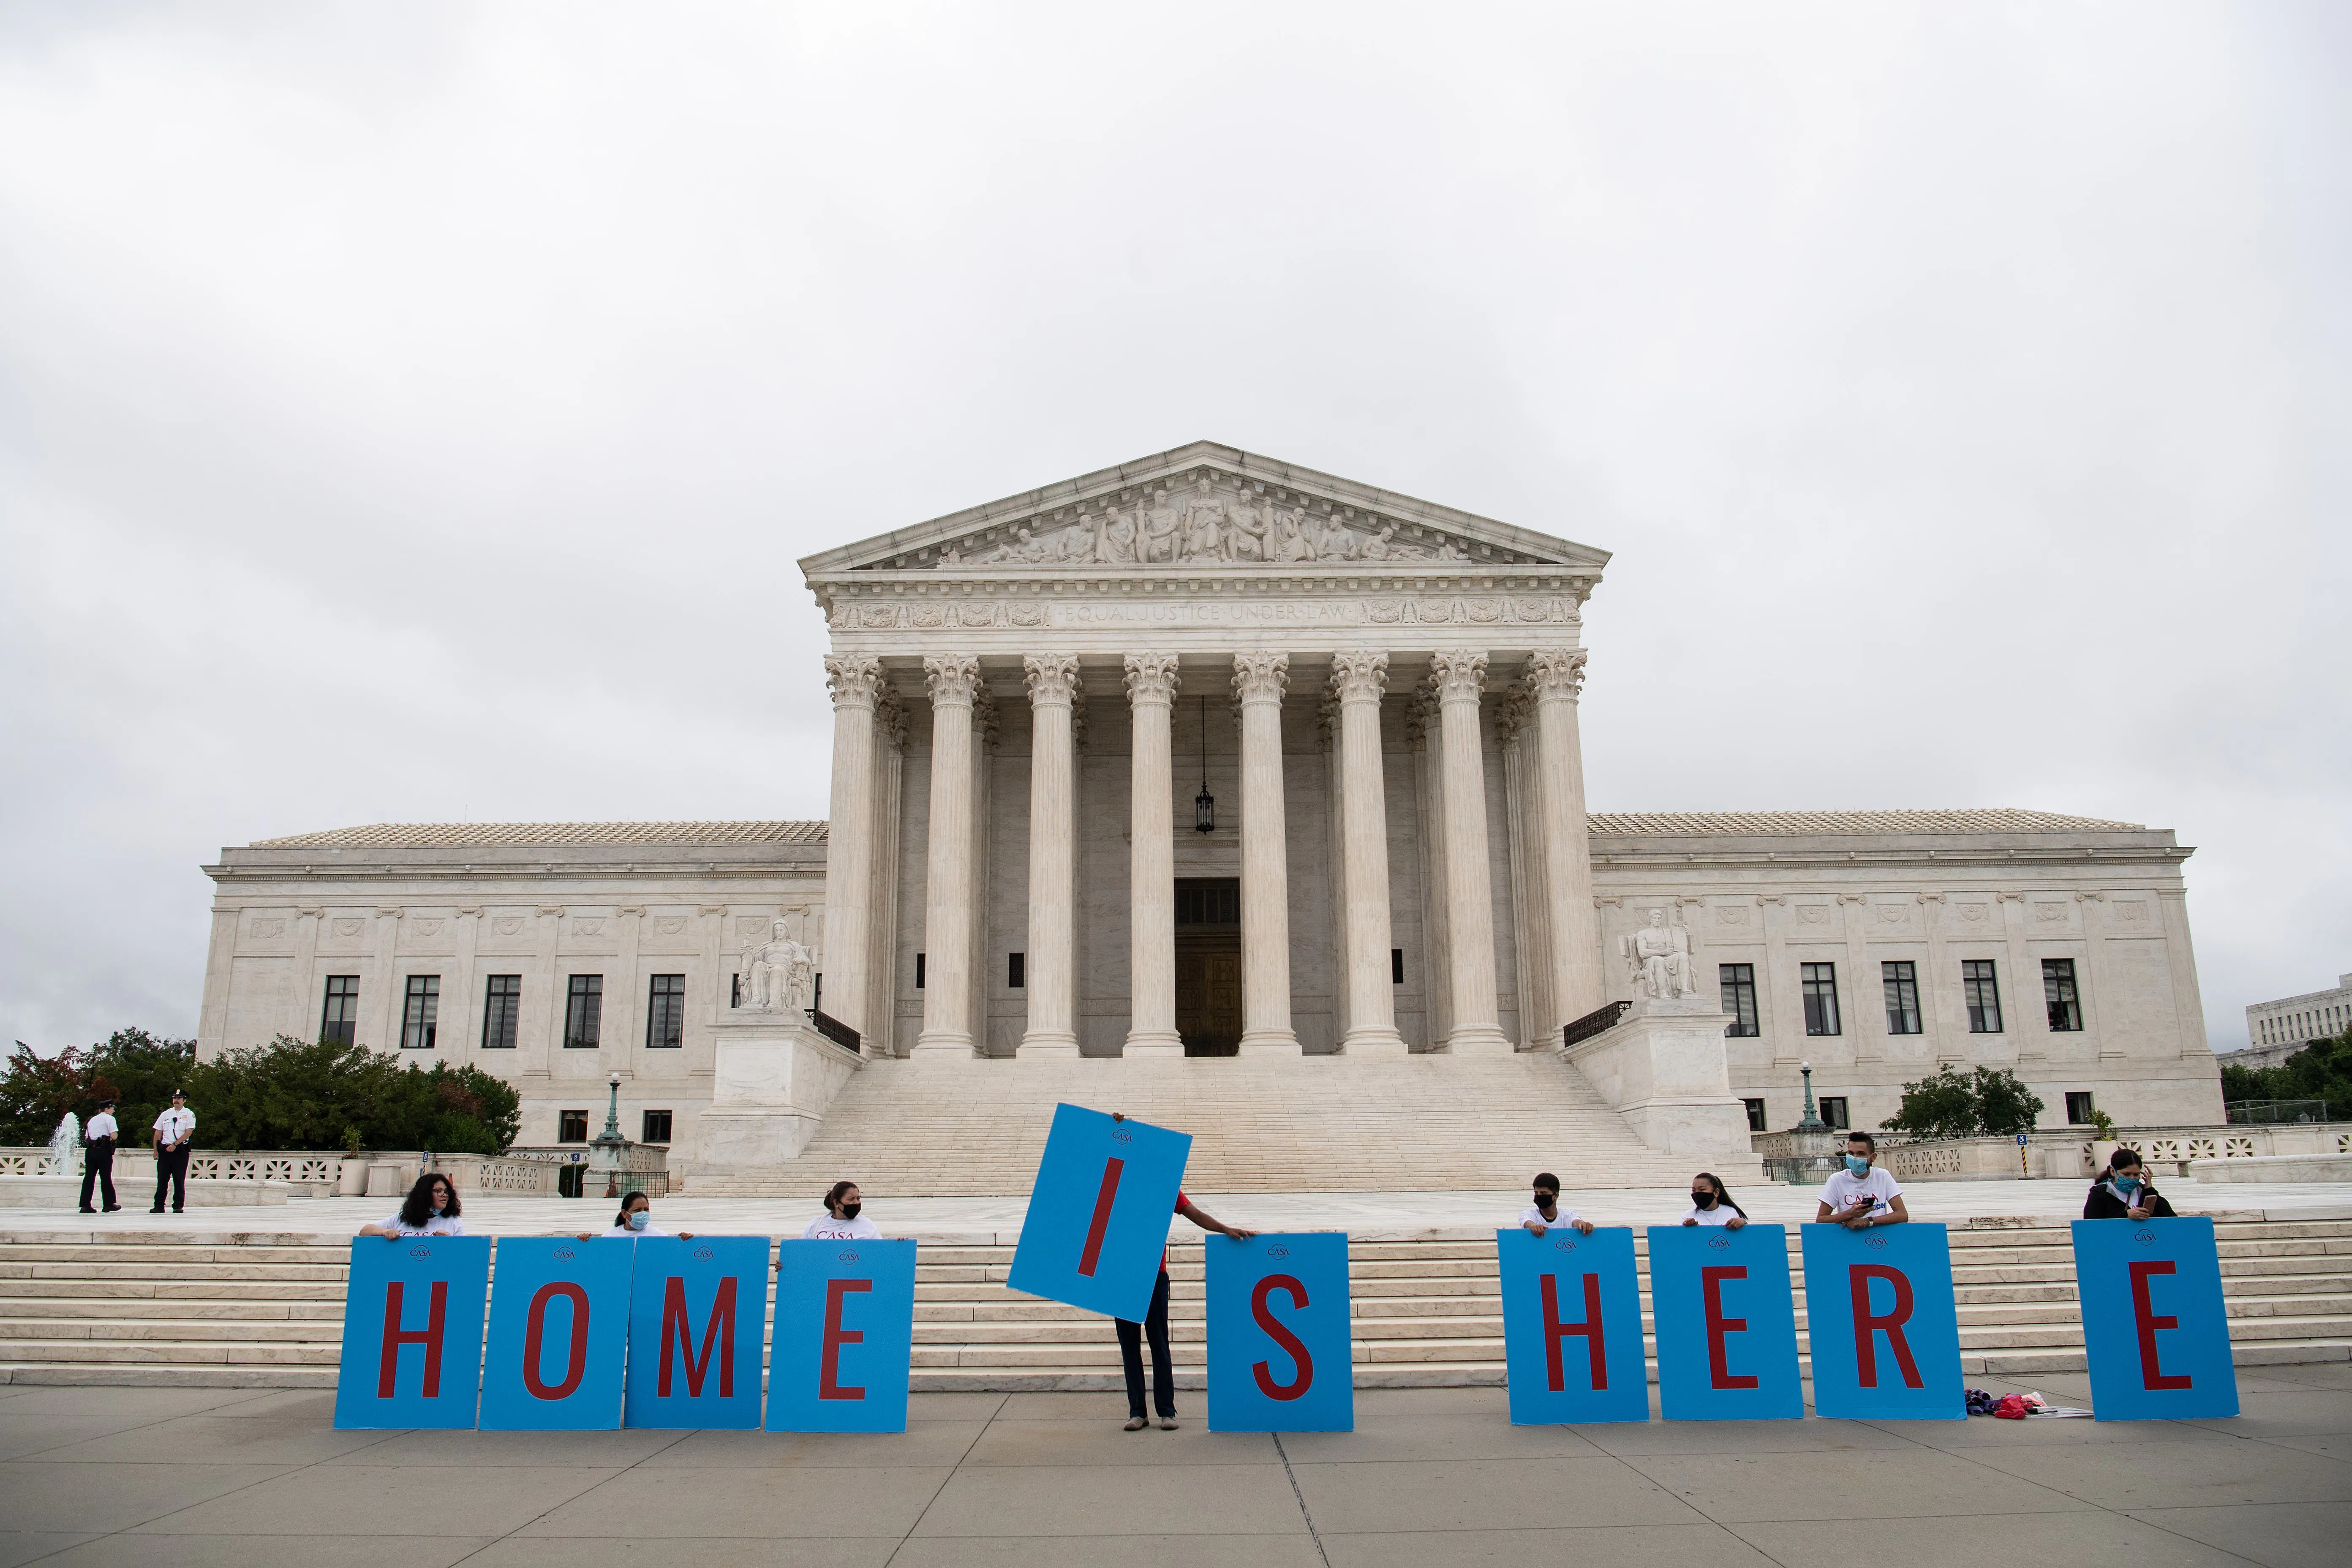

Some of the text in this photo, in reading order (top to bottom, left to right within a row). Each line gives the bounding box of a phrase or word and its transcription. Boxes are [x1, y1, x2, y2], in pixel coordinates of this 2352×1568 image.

[1064, 604, 1347, 622] EQUAL JUSTICE UNDER LAW
[1112, 1131, 1132, 1143] CASA
[2134, 1233, 2157, 1241] CASA
[409, 1249, 431, 1257] CASA
[553, 1250, 575, 1259] CASA
[693, 1250, 714, 1259] CASA
[1268, 1248, 1290, 1256] CASA
